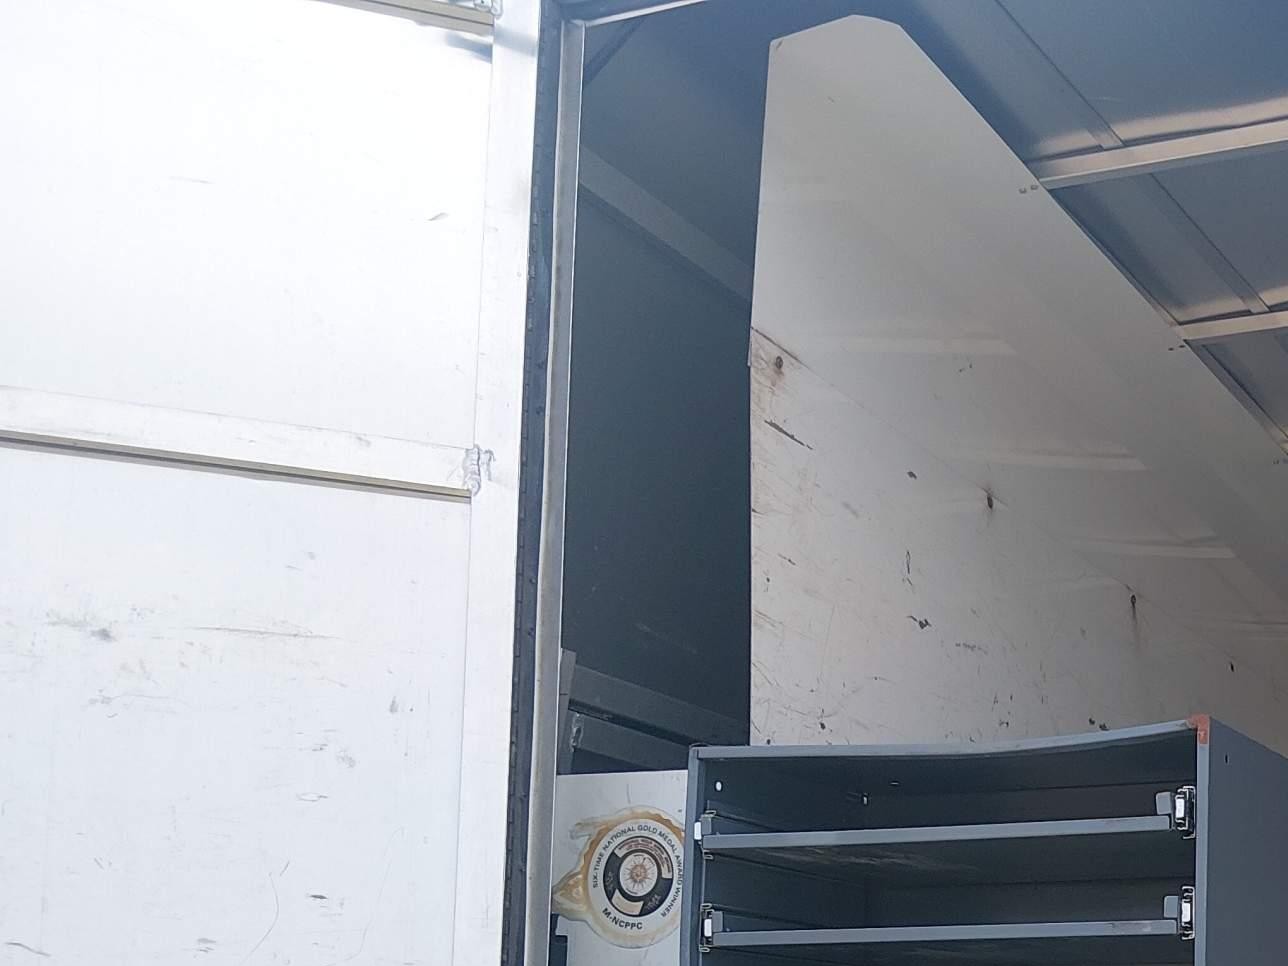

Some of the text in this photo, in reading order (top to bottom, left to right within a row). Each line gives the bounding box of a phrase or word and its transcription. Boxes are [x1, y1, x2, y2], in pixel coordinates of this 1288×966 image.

[602, 826, 636, 853] NATIONAL
[637, 824, 658, 834] GOLD
[658, 831, 679, 855] MEDAL
[660, 887, 681, 918] WINNER
